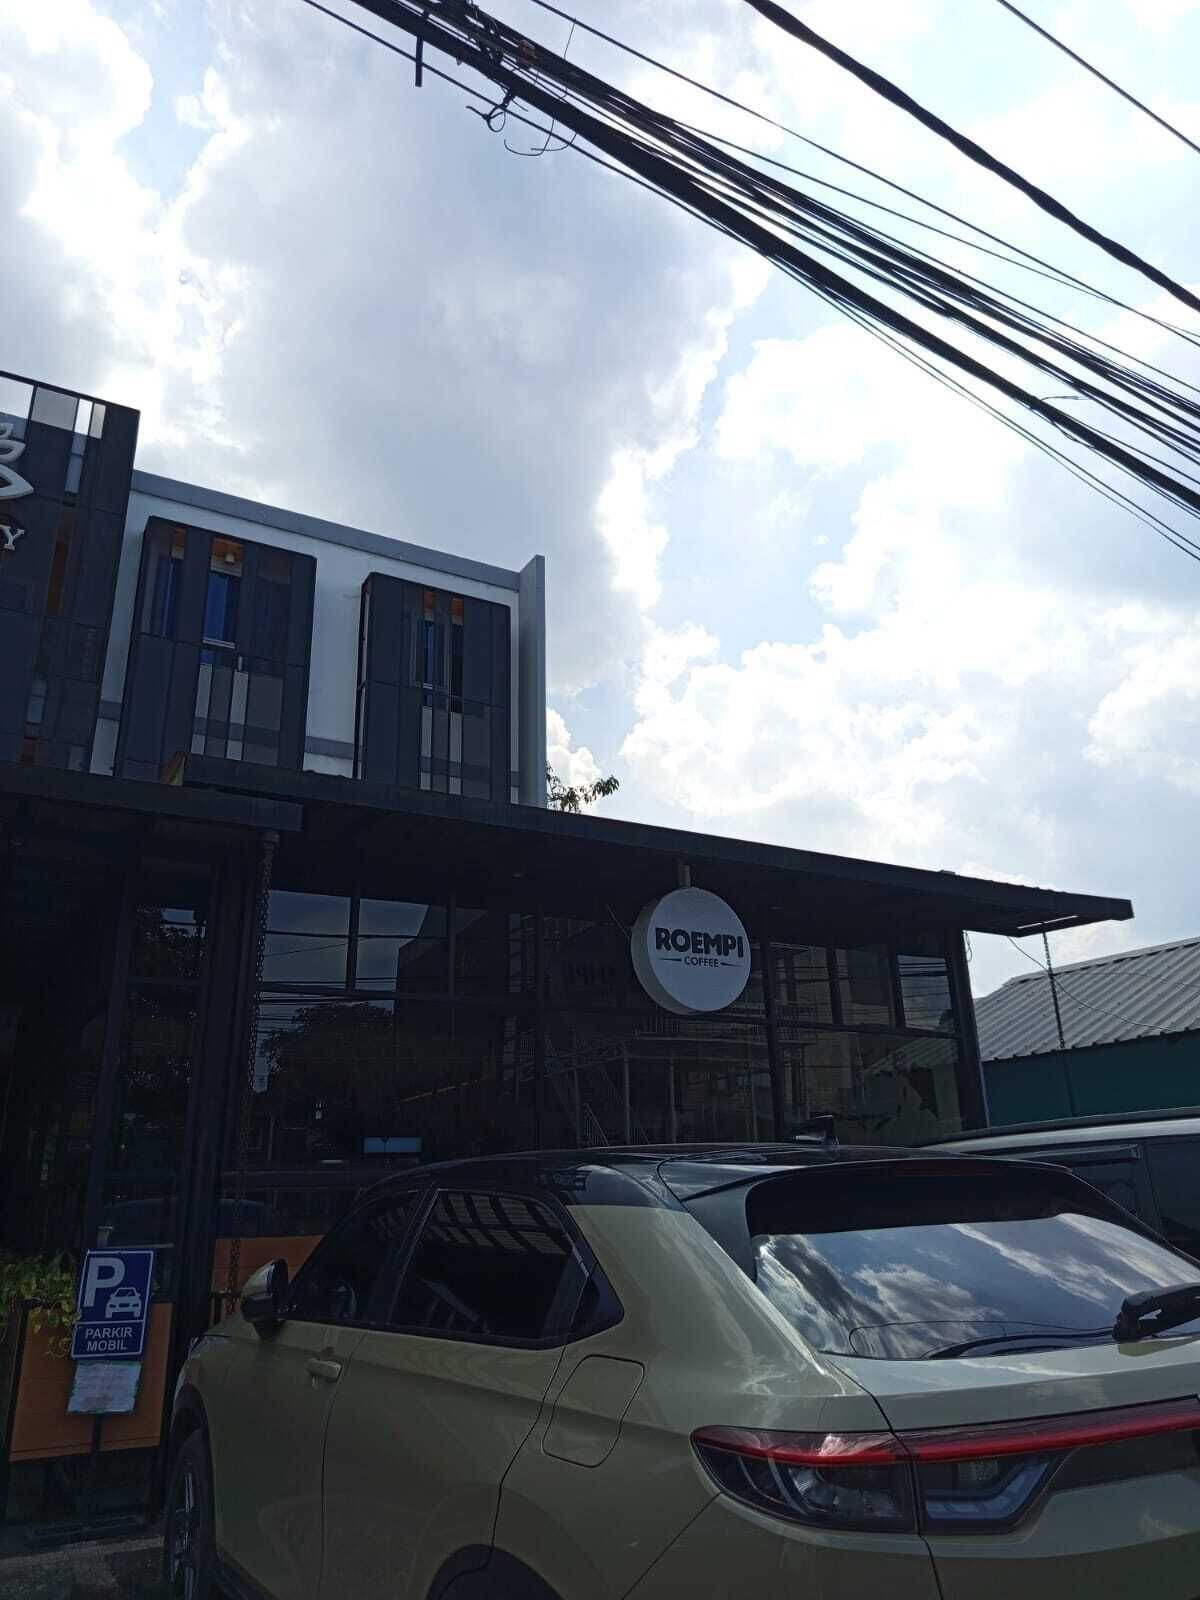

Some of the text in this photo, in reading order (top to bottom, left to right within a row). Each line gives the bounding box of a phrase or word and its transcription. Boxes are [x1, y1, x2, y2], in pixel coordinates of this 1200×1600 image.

[655, 927, 744, 958] ROEMPI
[684, 956, 719, 968] COFFEE
[83, 1257, 125, 1307] P
[85, 1327, 133, 1339] PARKIR
[86, 1339, 128, 1352] MOBIL
